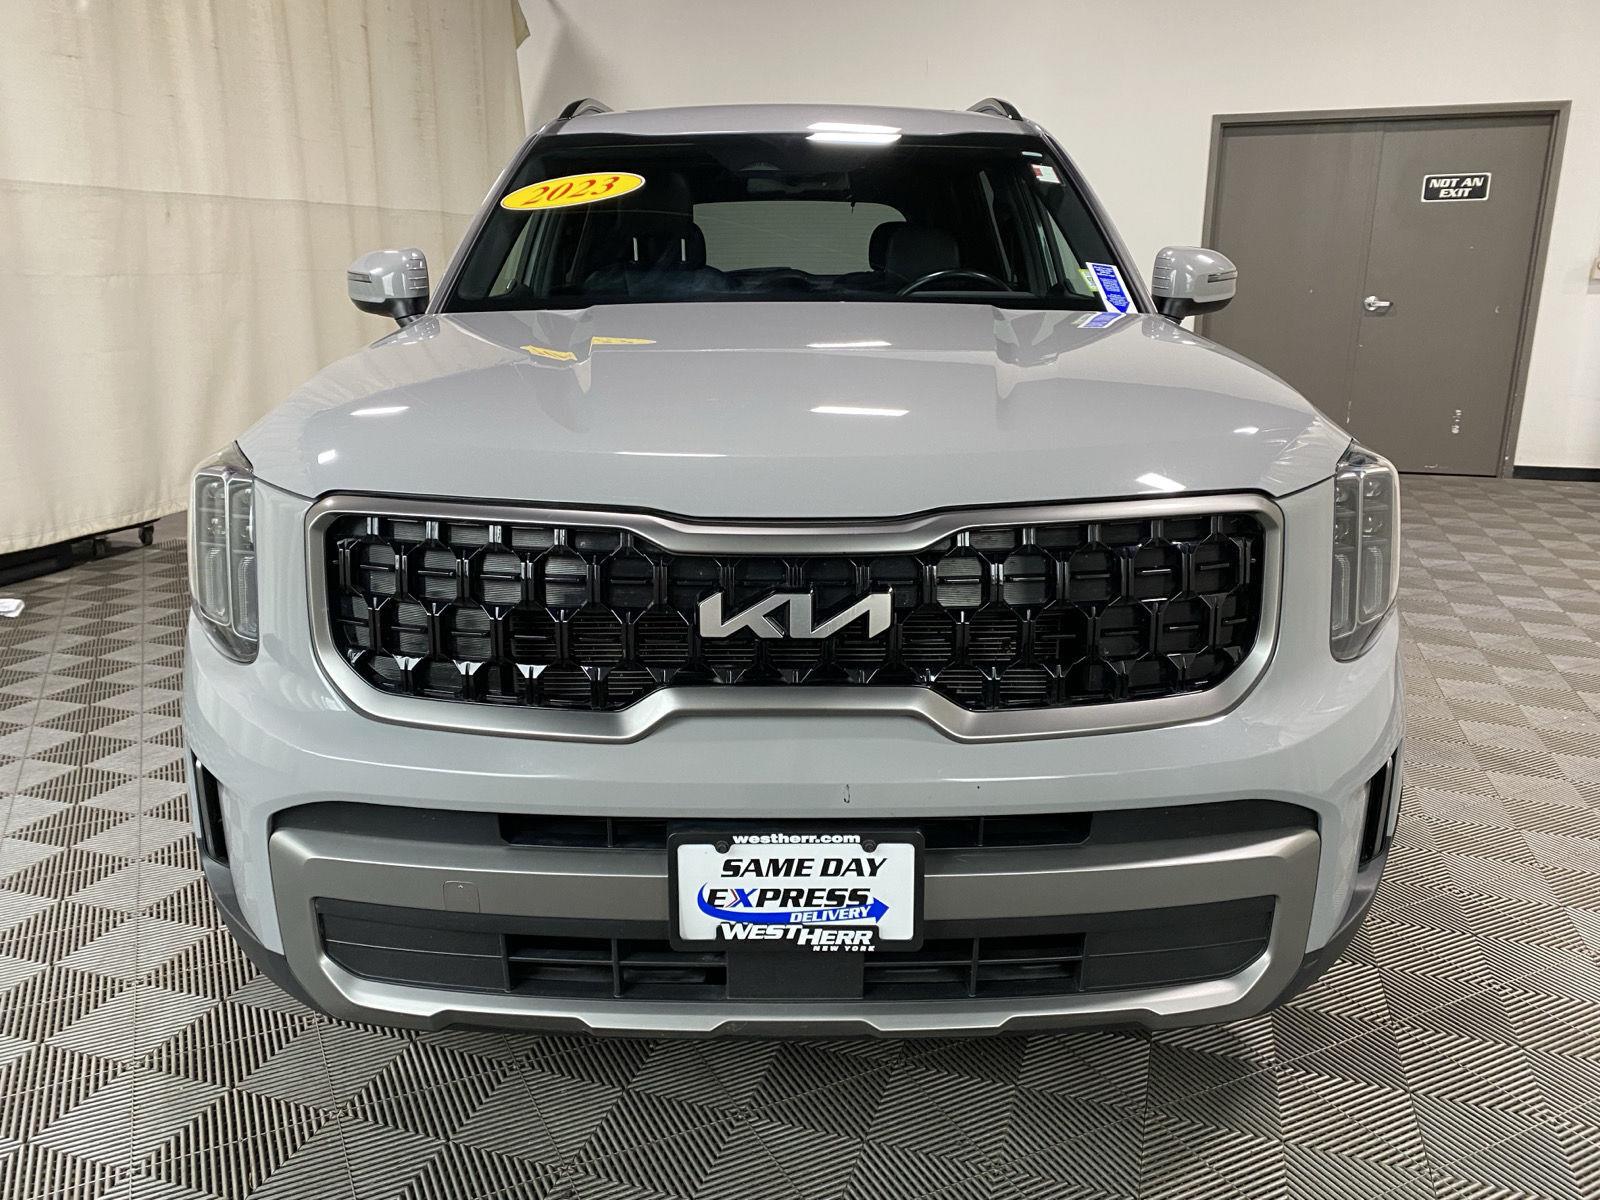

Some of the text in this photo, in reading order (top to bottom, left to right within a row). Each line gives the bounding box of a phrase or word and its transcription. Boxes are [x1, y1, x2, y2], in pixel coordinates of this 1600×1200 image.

[520, 176, 620, 206] 2023
[1429, 177, 1484, 188] NOT AN
[1439, 188, 1473, 198] EXIT
[699, 592, 892, 639] KIA
[733, 833, 861, 845] westherr.com
[720, 858, 888, 878] SAME DAY
[706, 888, 872, 908] EXPRESS
[789, 904, 872, 924] DELIVERY
